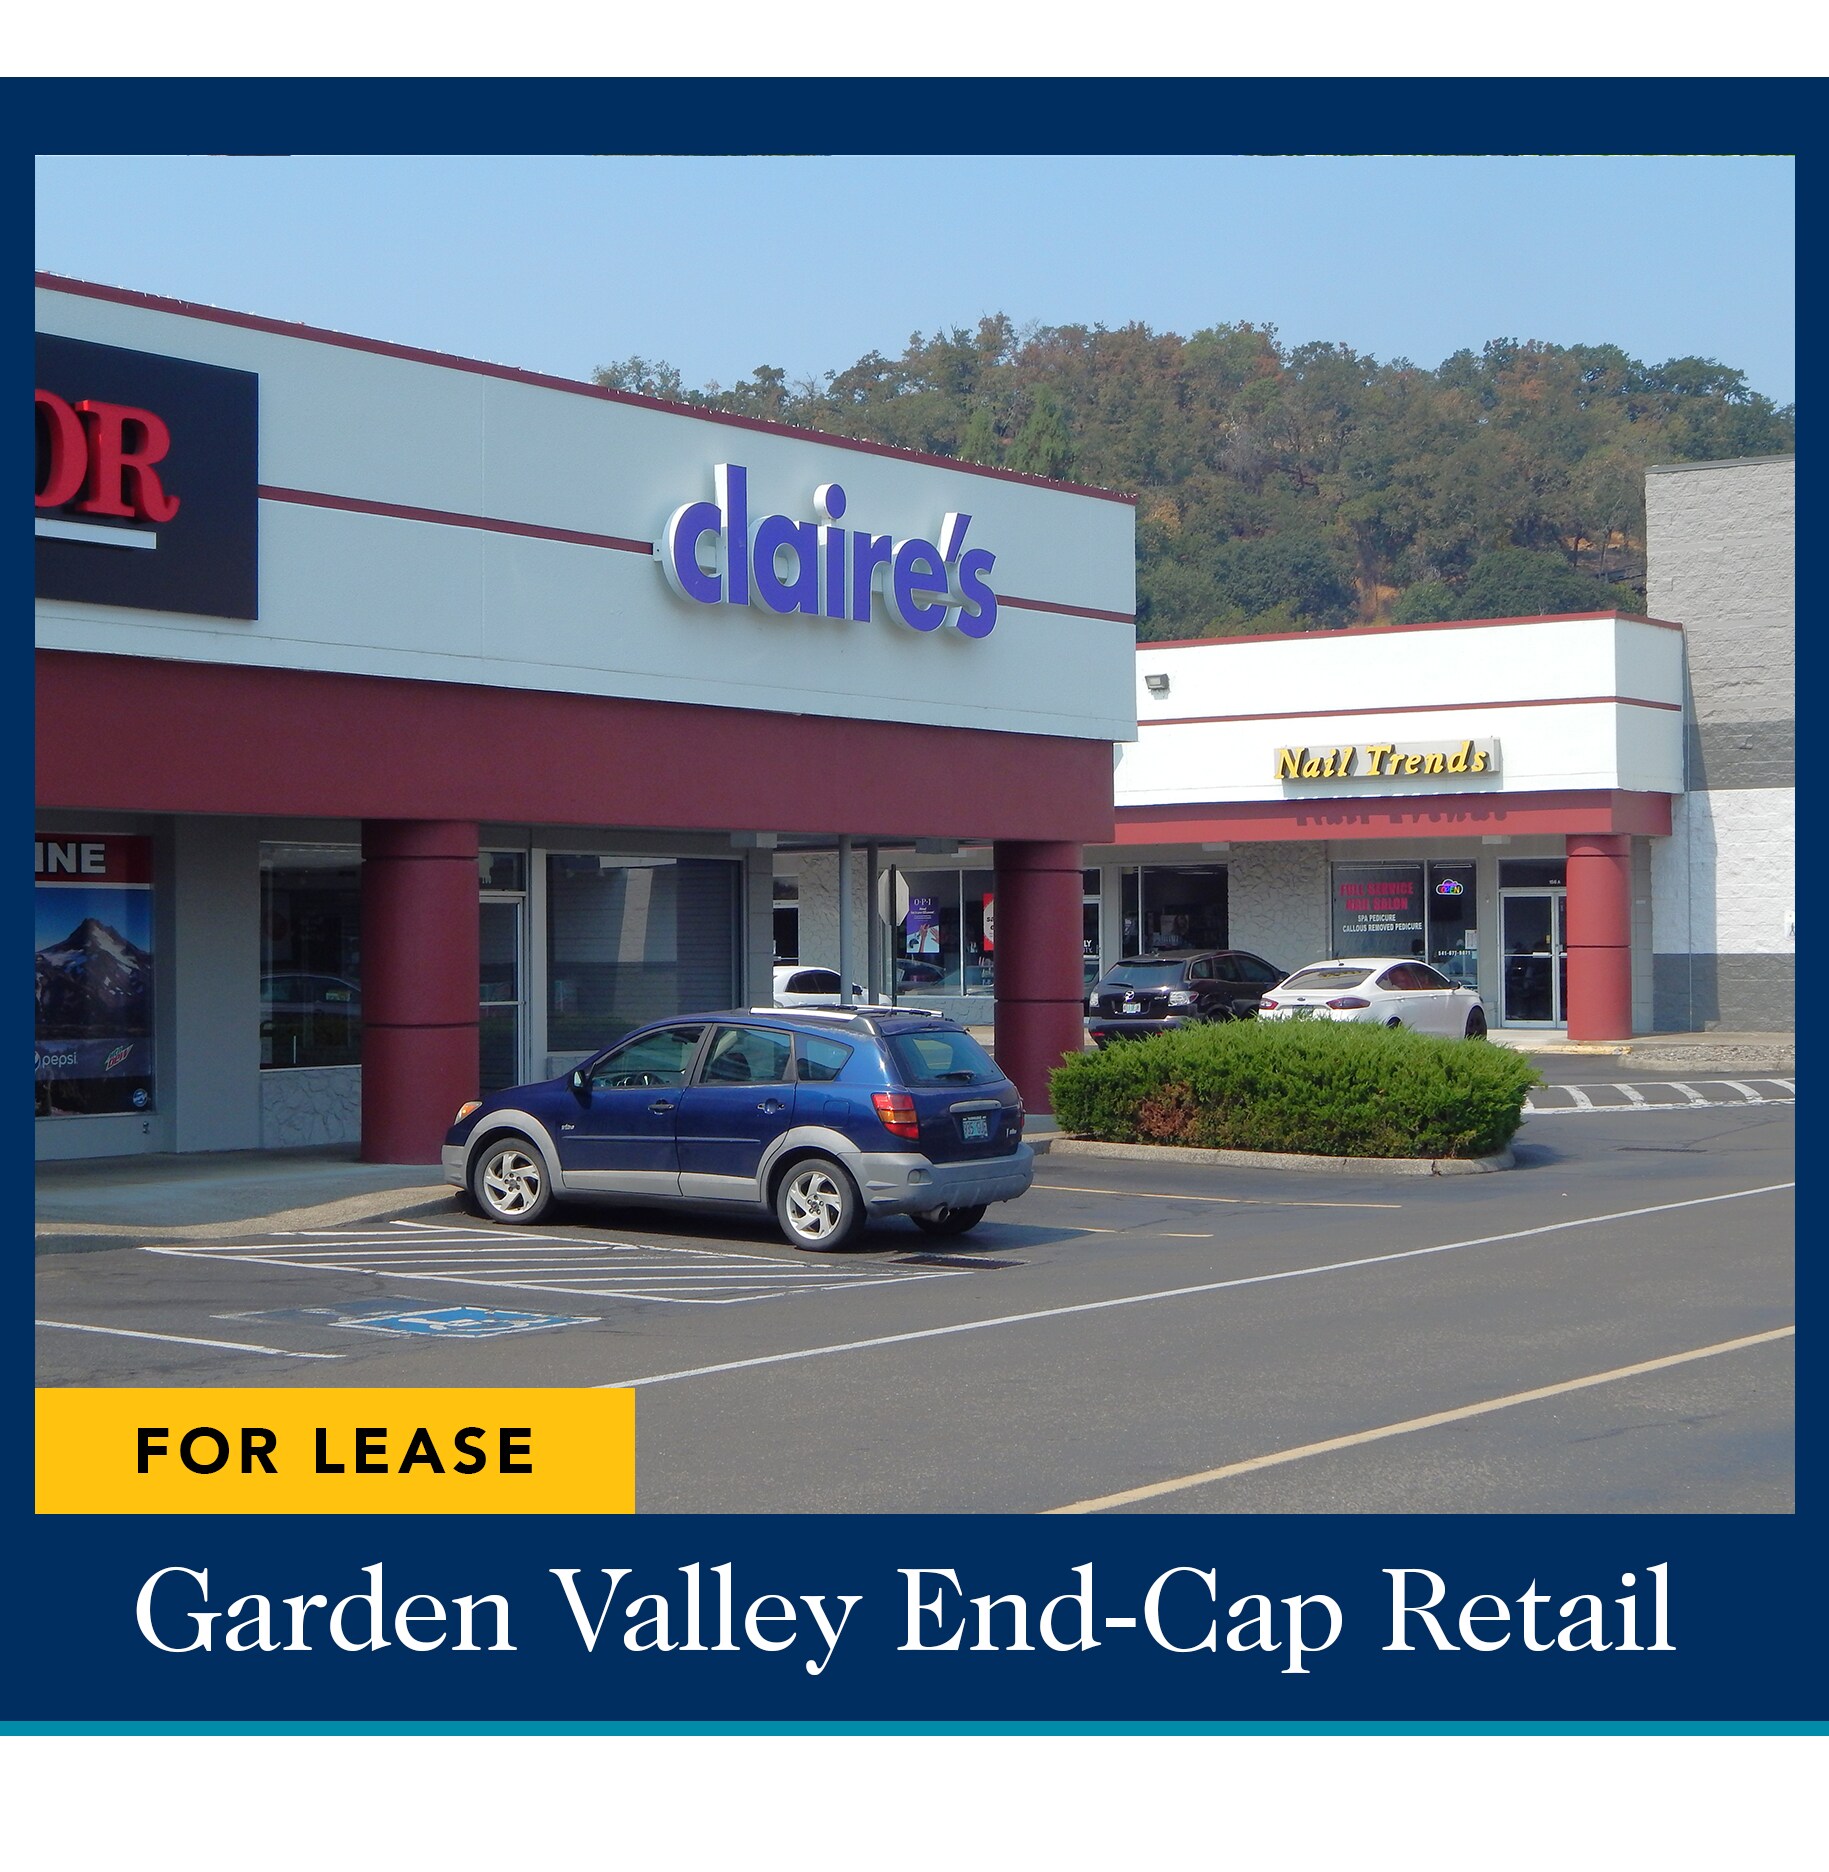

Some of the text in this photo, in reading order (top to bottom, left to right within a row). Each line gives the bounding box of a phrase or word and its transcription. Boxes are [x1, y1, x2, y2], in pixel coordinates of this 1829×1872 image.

[665, 465, 997, 639] claire's
[1274, 740, 1489, 779] Nail Trends
[35, 841, 106, 874] INE
[1341, 882, 1414, 896] FULL SERVICE
[1346, 897, 1408, 910] NAIL SALON
[1357, 913, 1397, 923] SPA PEDICURE
[1342, 922, 1423, 933] CALLOUS REMOVED PEDICURE
[42, 1052, 77, 1068] pepsi
